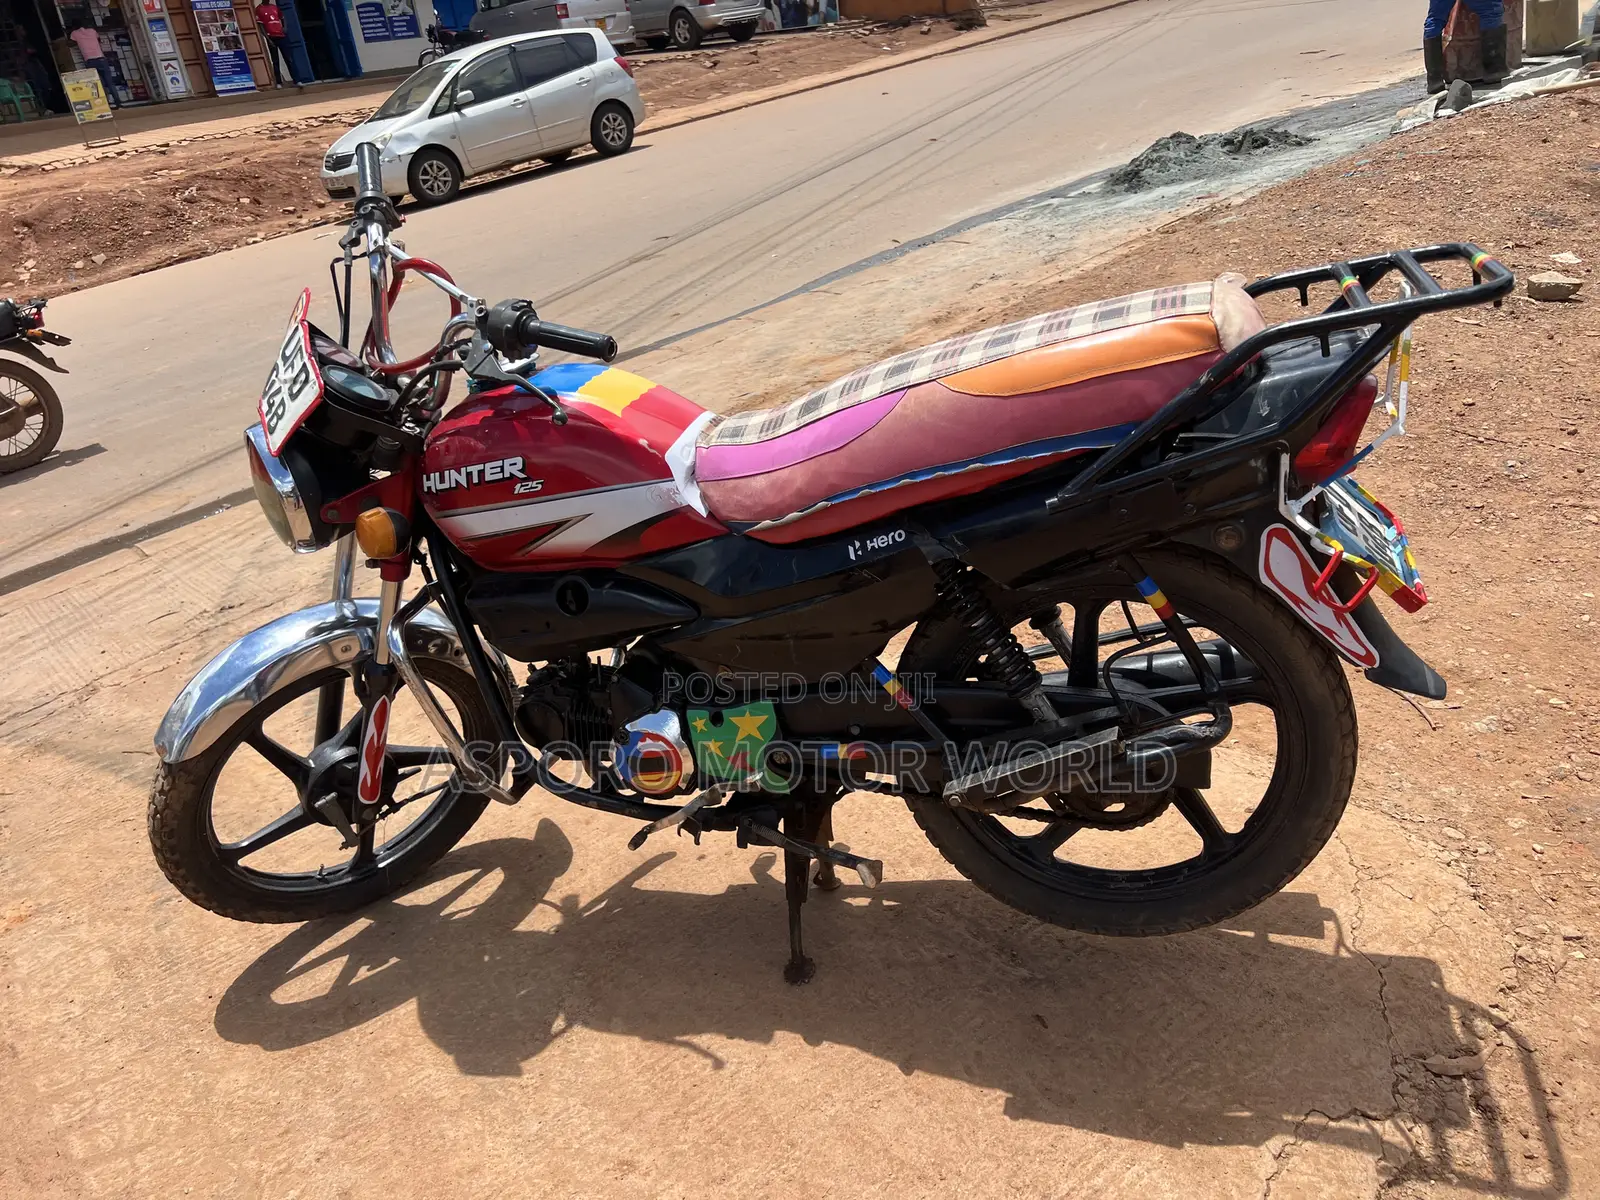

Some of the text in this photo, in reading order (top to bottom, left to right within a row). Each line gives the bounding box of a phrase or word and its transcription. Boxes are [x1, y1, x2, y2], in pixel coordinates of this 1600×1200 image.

[422, 456, 528, 494] HUNTER
[513, 479, 544, 494] 125
[866, 529, 906, 552] Hero
